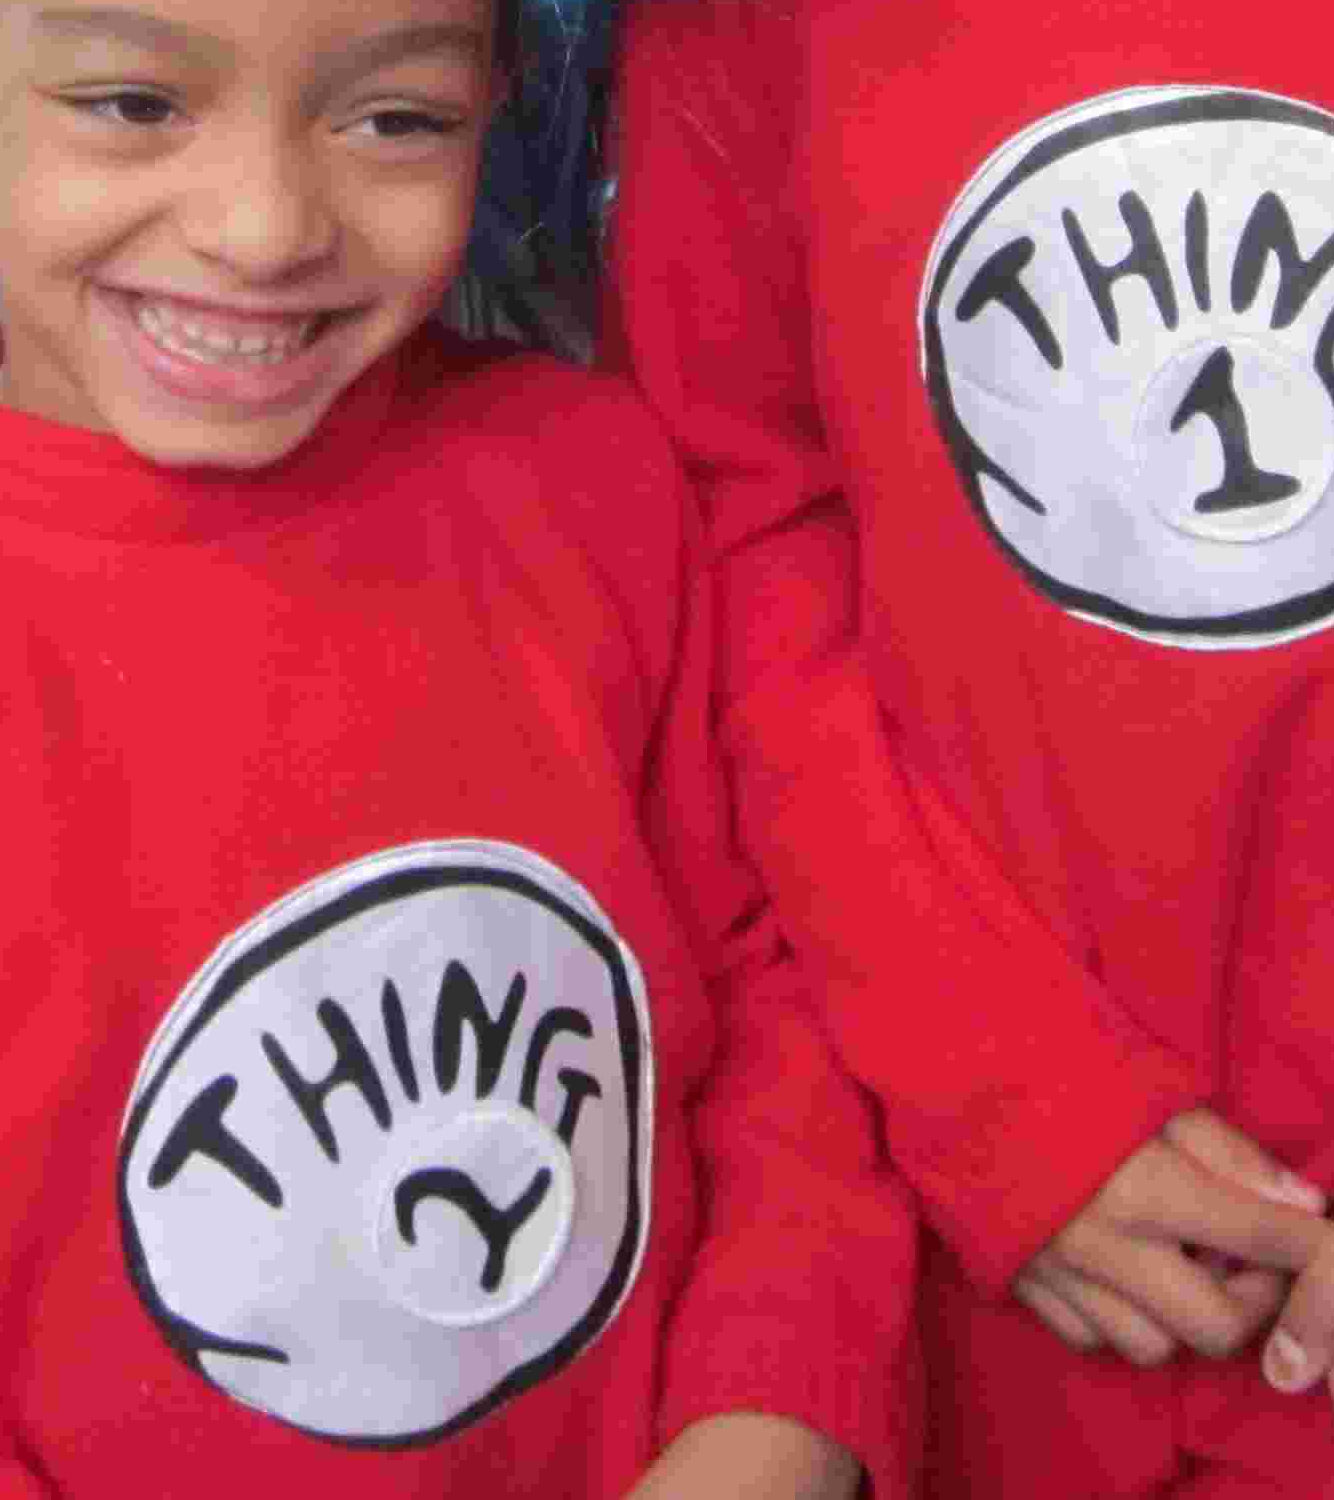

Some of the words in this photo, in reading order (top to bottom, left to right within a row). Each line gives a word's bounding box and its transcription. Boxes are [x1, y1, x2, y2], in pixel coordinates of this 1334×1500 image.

[1170, 345, 1302, 514] 1
[147, 959, 603, 1210] THING
[394, 1166, 553, 1293] 2
